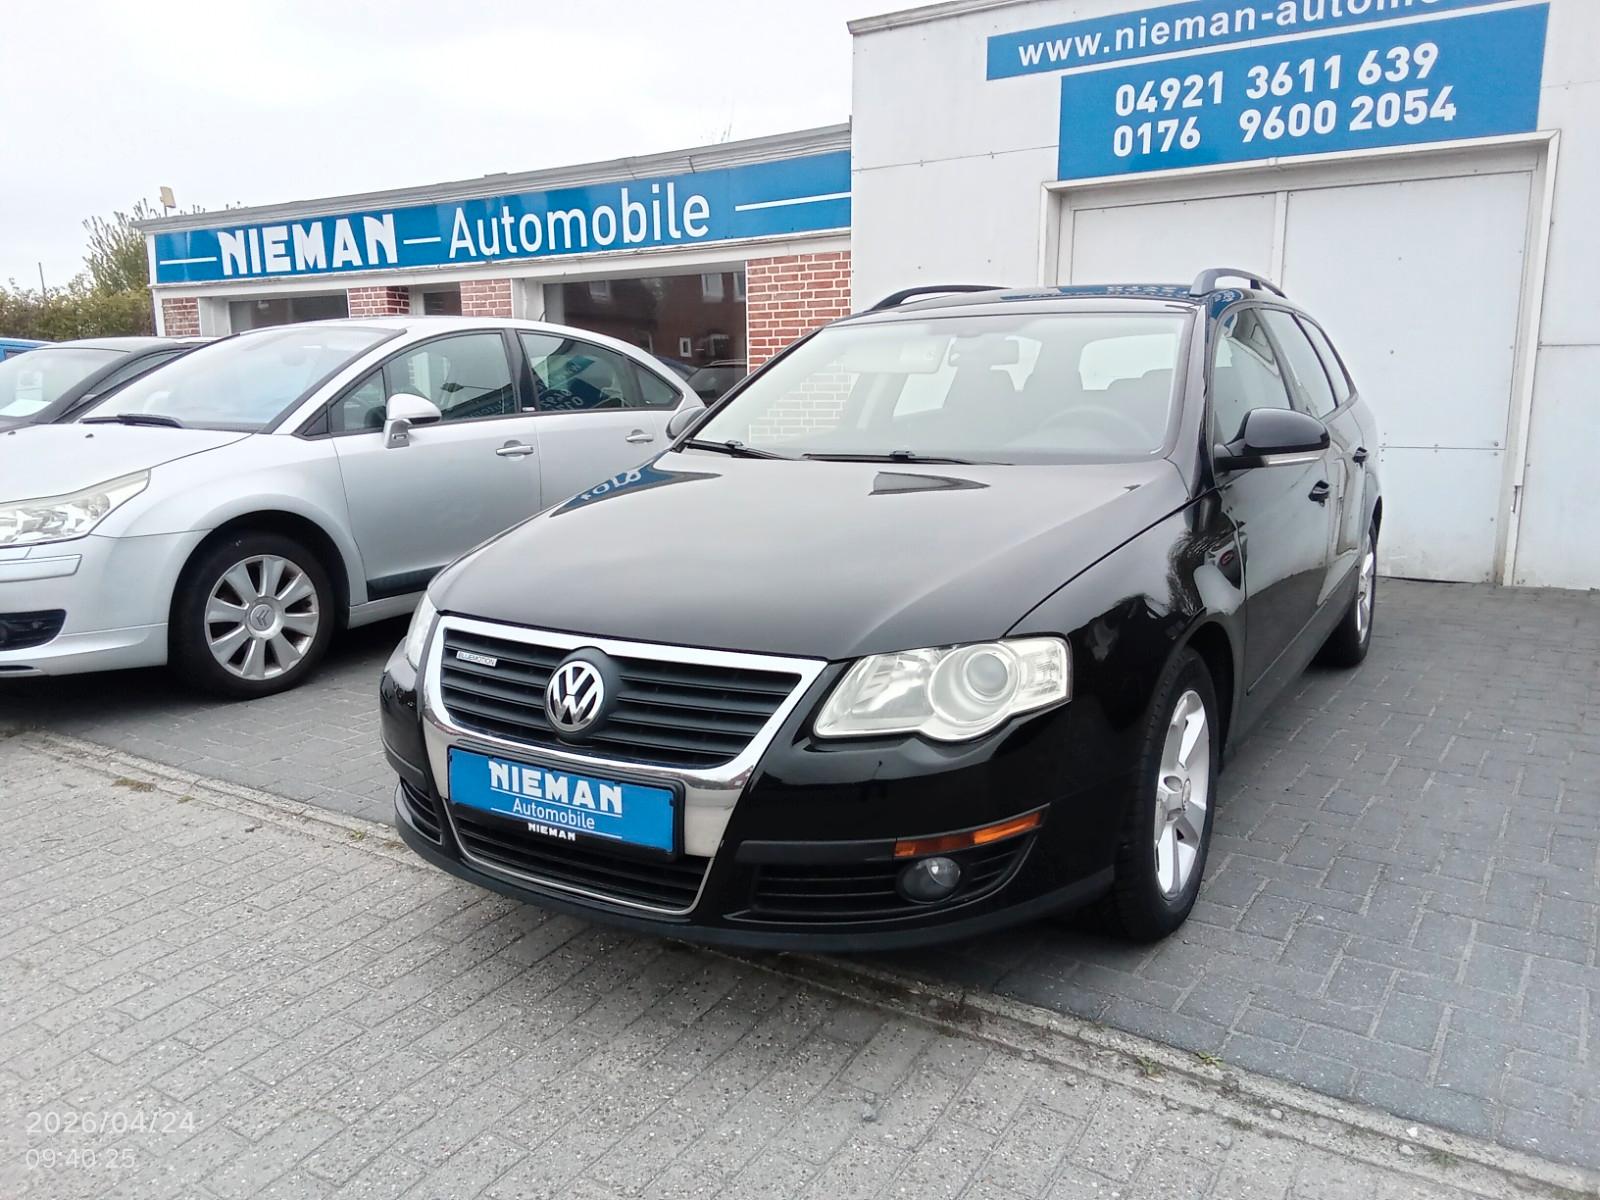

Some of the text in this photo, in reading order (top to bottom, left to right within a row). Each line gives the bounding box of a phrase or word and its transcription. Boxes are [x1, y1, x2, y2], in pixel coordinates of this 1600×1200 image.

[1115, 42, 1439, 117] 04921 3611 639
[1112, 86, 1456, 157] 0176 9600 2054
[217, 182, 710, 276] NIEMAN Automobile
[488, 761, 623, 814] NIEMAN
[512, 798, 595, 830] Automobile
[528, 823, 576, 841] NIEMAN
